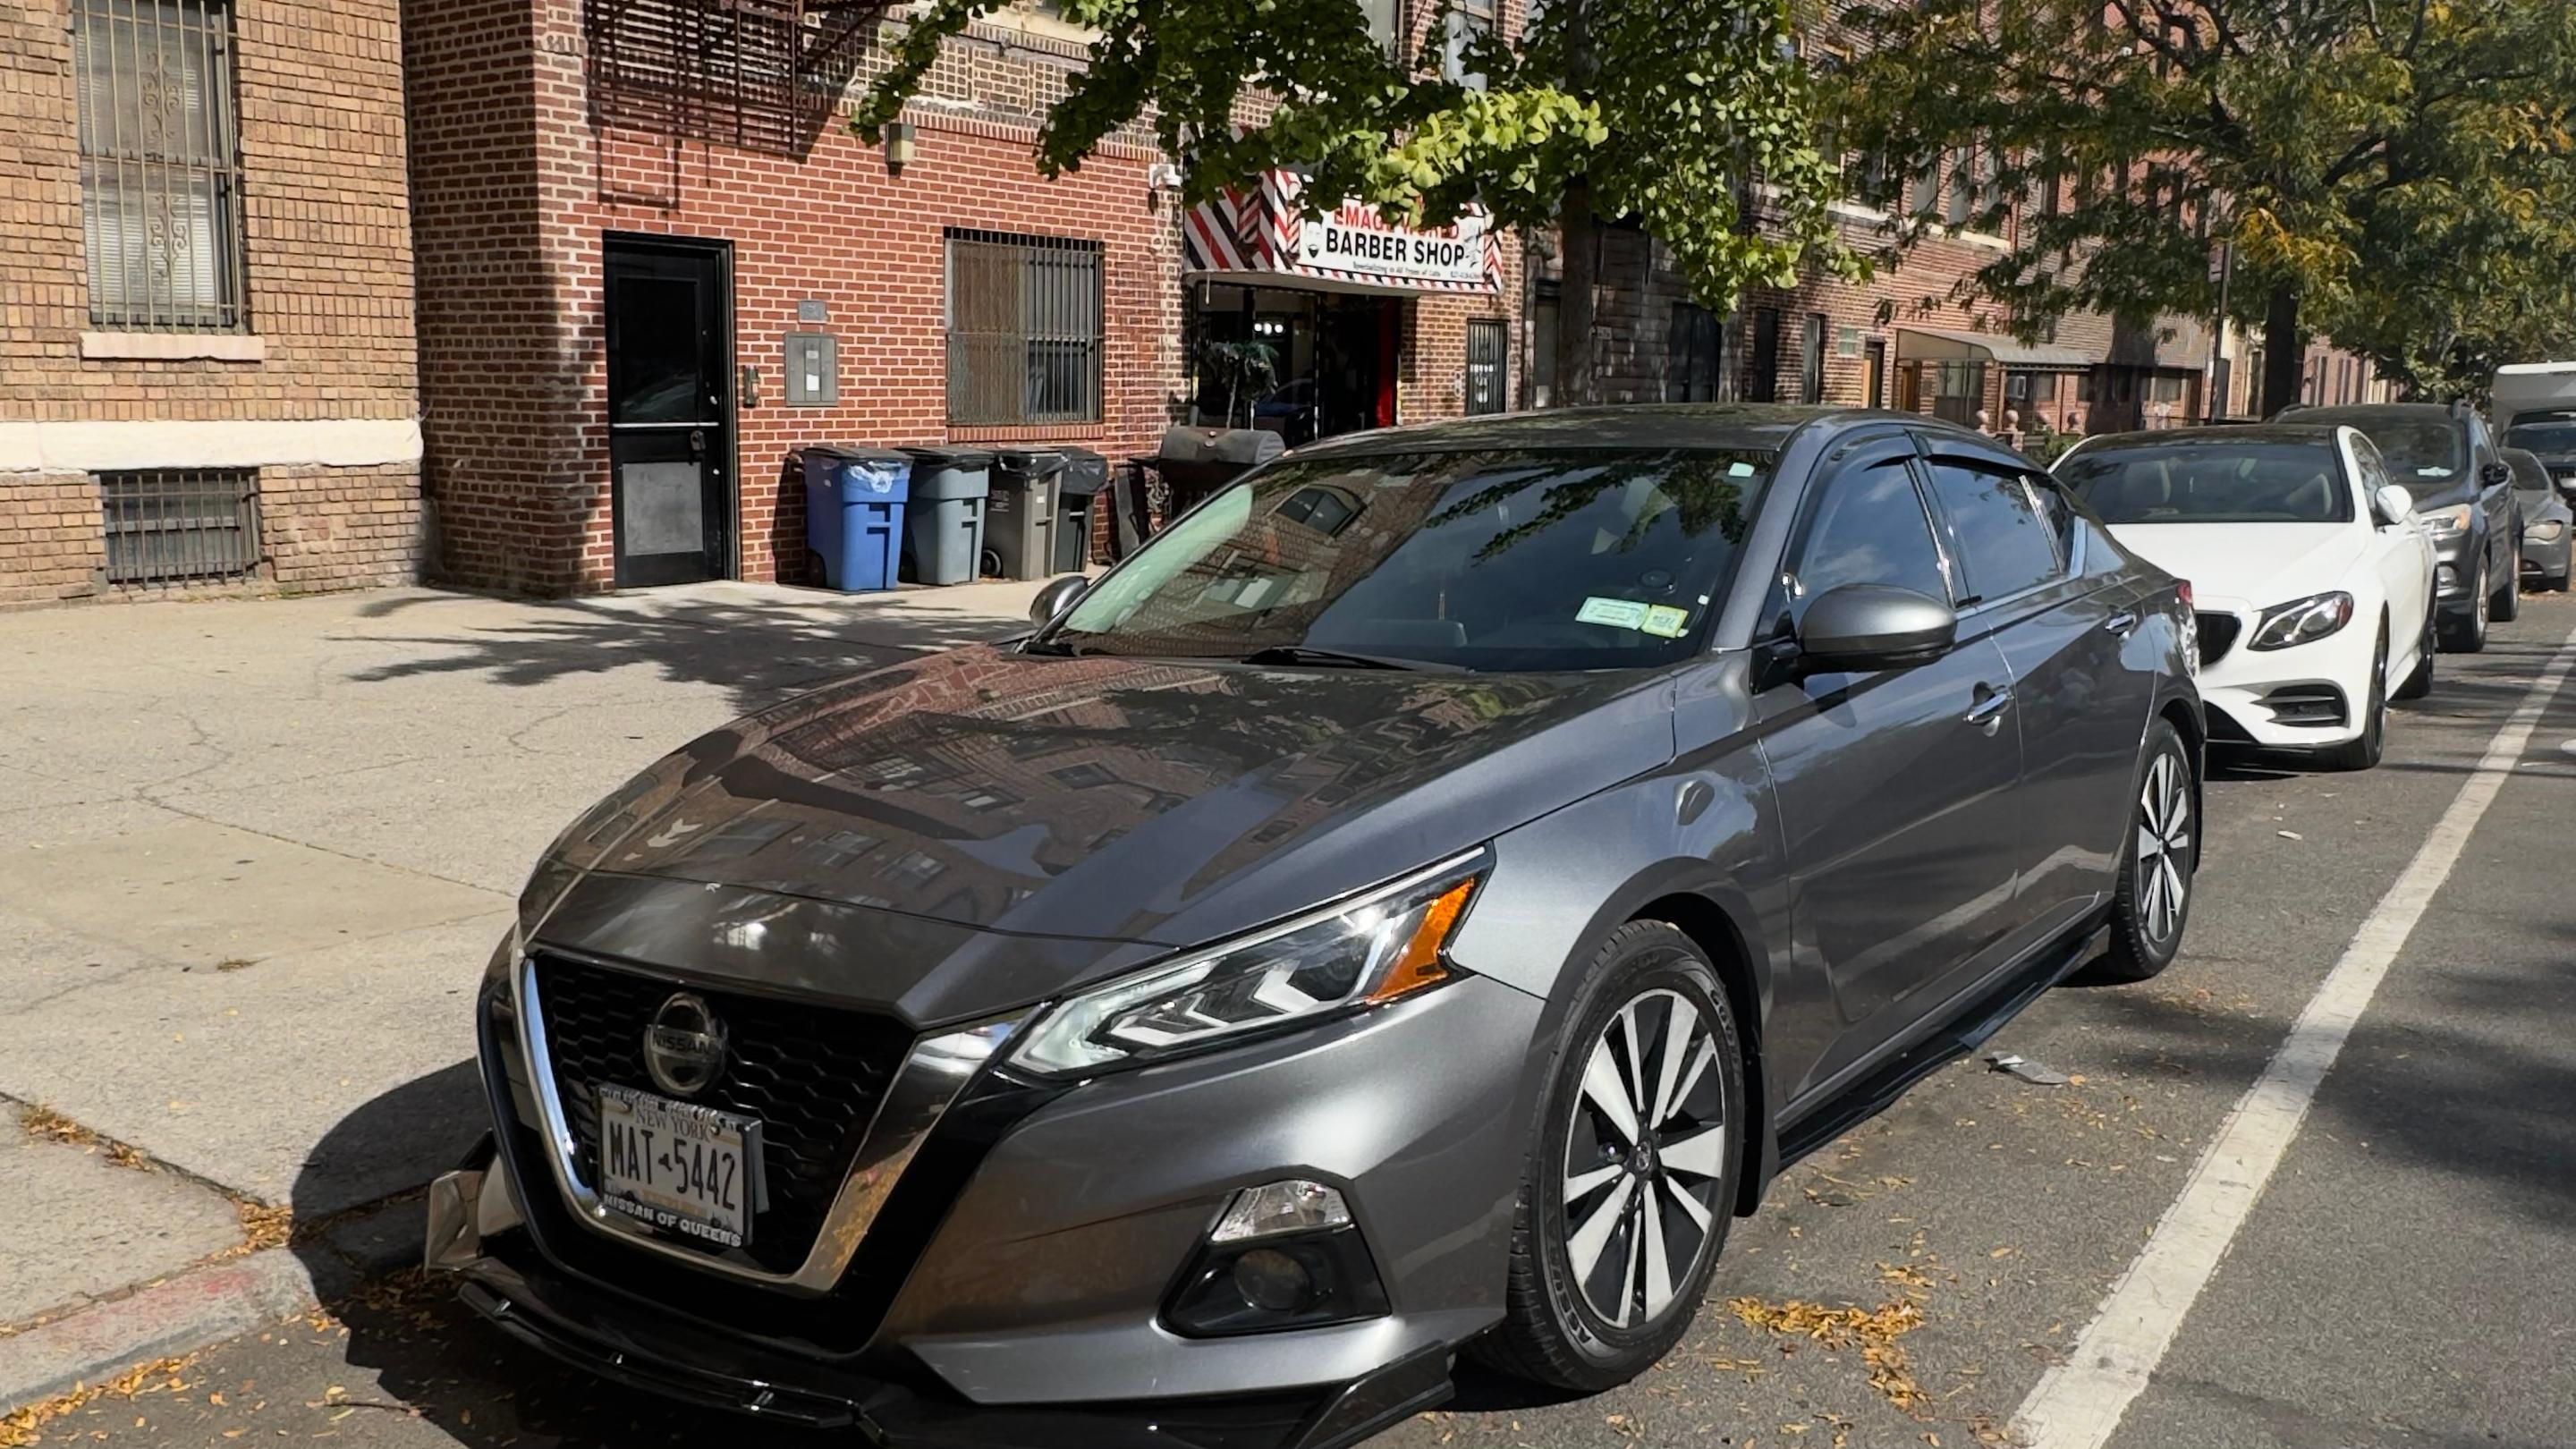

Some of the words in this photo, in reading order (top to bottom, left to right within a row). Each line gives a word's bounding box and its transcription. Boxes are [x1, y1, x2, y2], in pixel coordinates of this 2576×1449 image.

[1326, 228, 1407, 262] BARBER
[1414, 240, 1464, 267] SHOP
[653, 1032, 711, 1055] NISSAN
[636, 1108, 668, 1130] NEW
[671, 1117, 710, 1143] YORK
[610, 1121, 654, 1185] MAT
[674, 1137, 735, 1211] 5442
[604, 1193, 654, 1222] NISSAN
[657, 1212, 677, 1227] OF
[679, 1219, 742, 1248] QUEENS
